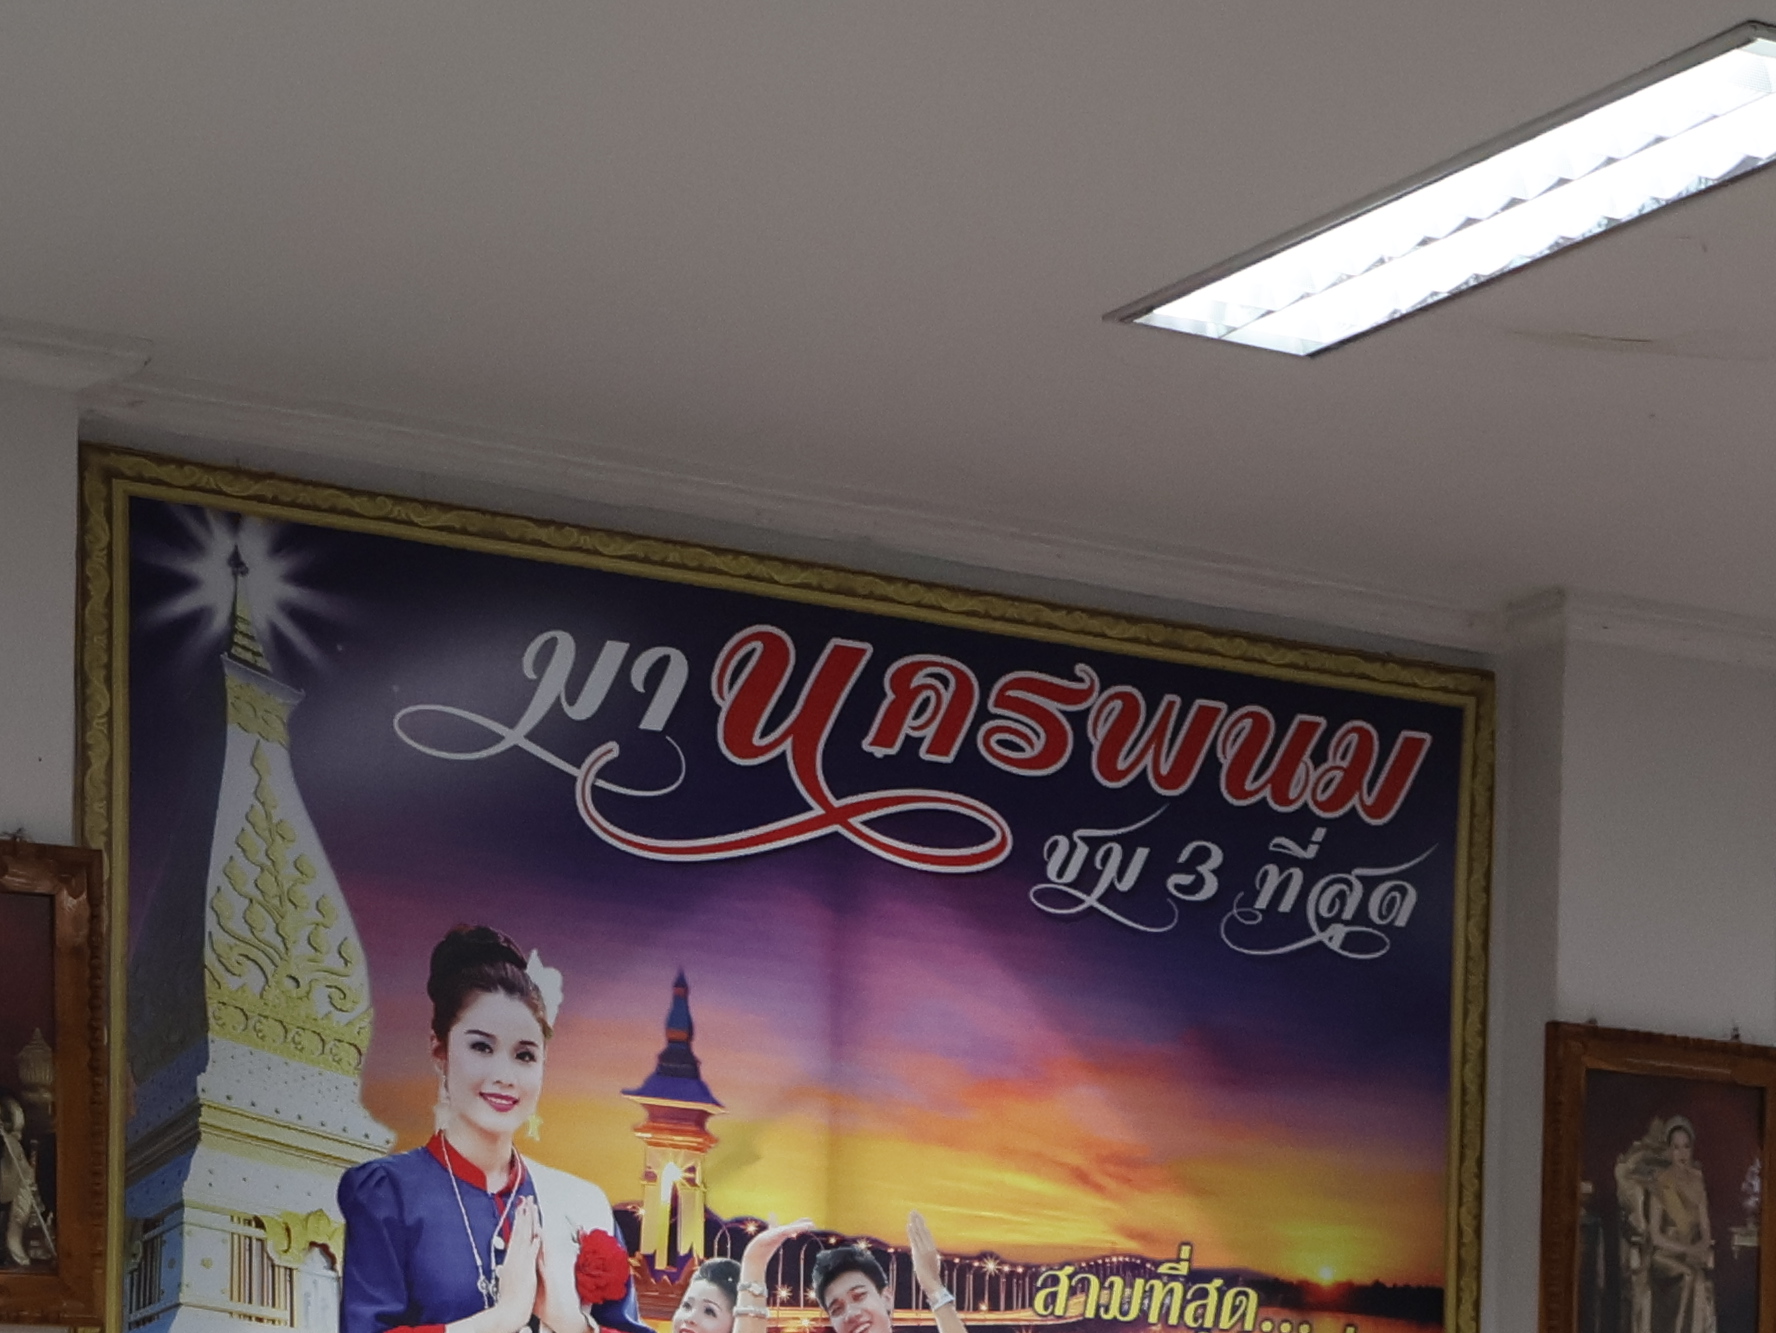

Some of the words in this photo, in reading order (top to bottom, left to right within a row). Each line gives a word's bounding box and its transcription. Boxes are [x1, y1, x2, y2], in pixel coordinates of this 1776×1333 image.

[1029, 804, 1177, 931] ชม
[1167, 839, 1223, 903] 3
[1220, 827, 1437, 958] ที่สุด
